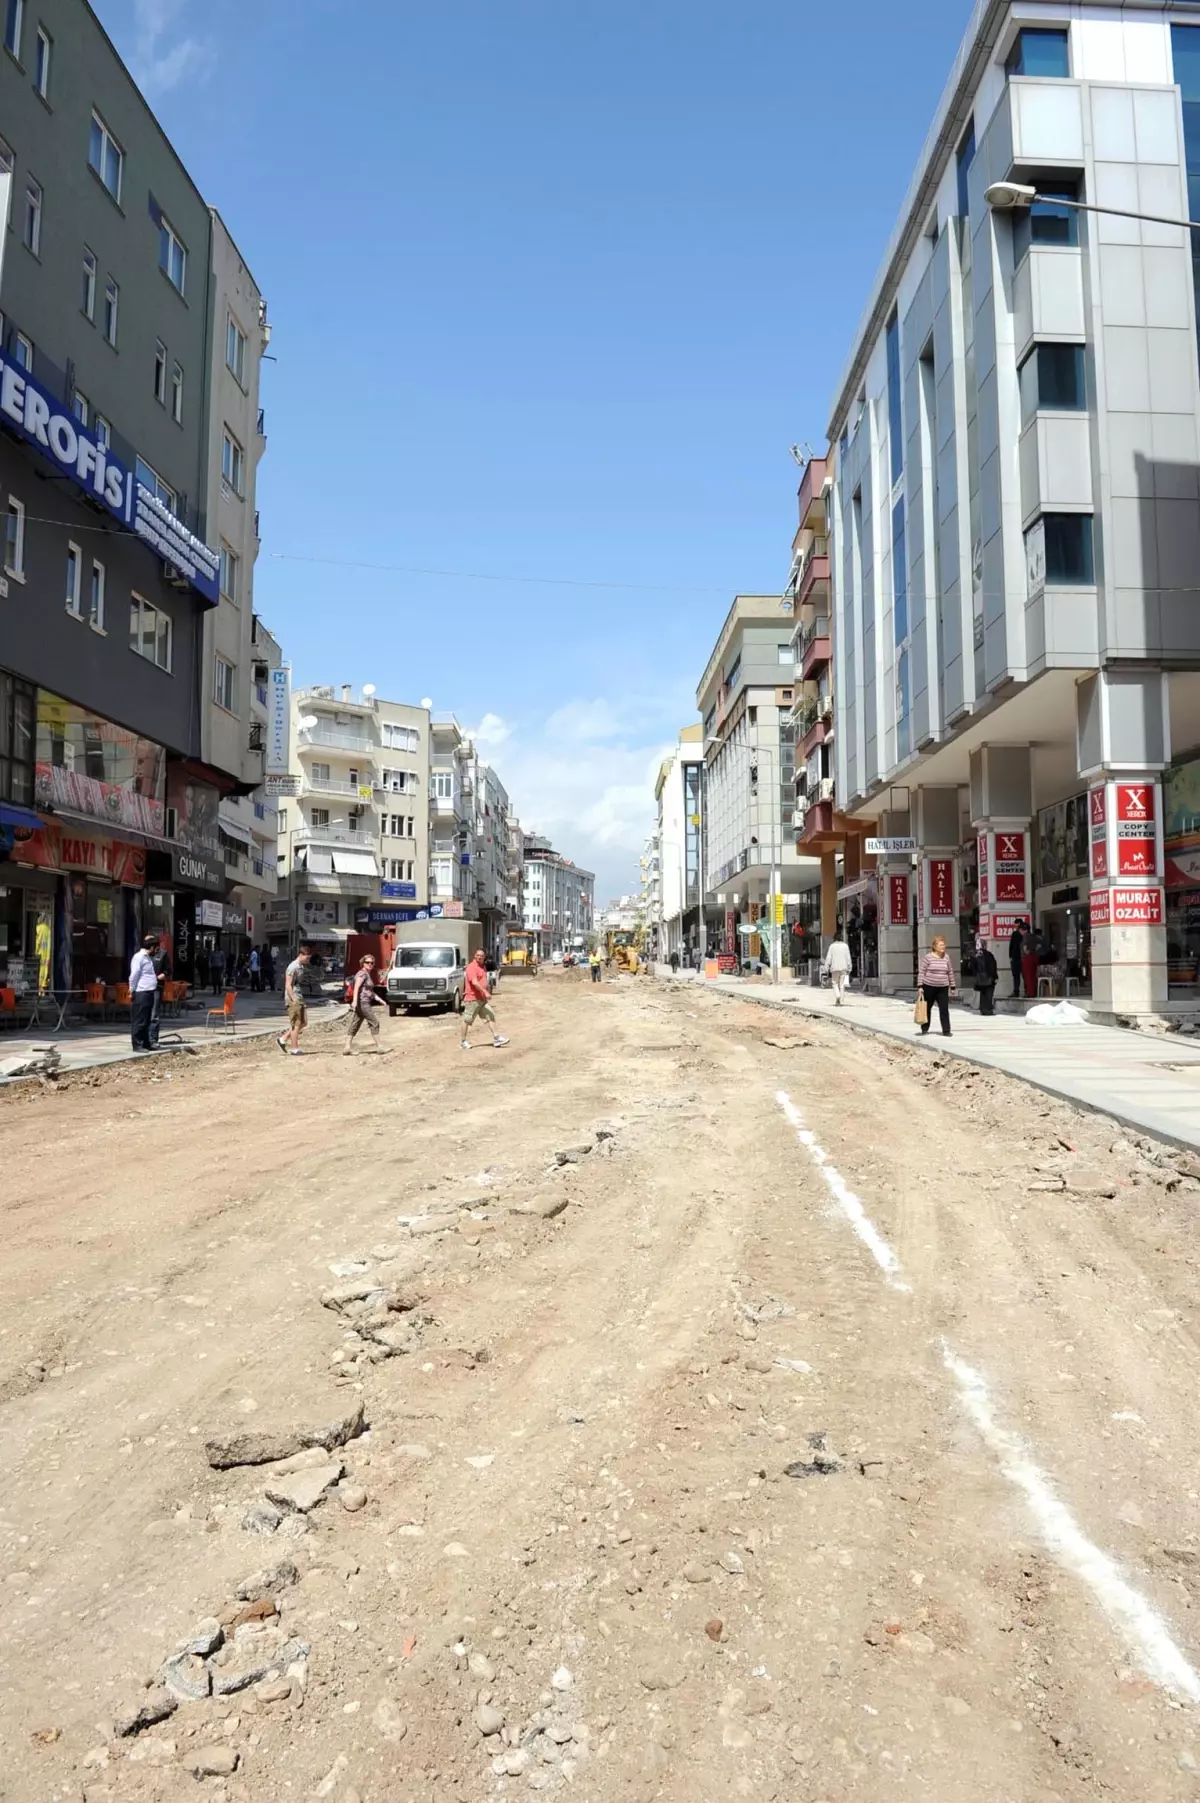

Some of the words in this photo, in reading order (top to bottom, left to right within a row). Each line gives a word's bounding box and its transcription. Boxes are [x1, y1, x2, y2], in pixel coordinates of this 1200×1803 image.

[1125, 789, 1146, 810] X
[62, 838, 96, 867] KAYA
[1002, 836, 1017, 853] X
[1116, 893, 1157, 904] MURAT
[1116, 907, 1159, 919] OZALİT
